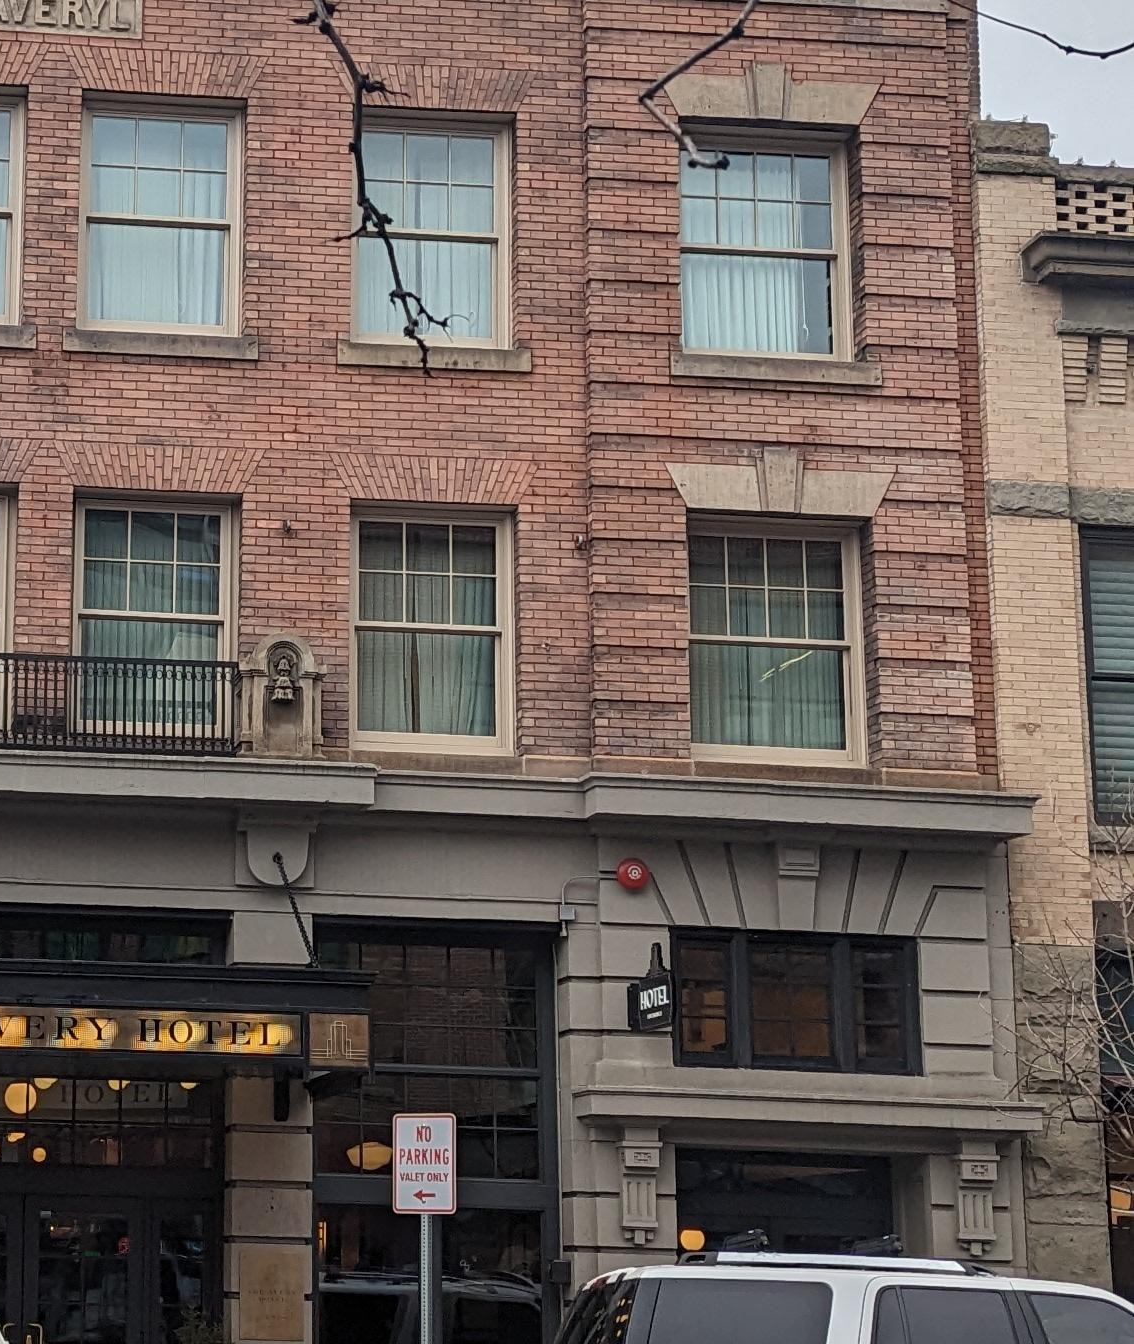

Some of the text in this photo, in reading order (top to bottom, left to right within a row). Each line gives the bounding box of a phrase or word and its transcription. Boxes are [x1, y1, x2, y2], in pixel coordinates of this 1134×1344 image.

[640, 985, 669, 1011] HOTEL
[138, 1018, 282, 1047] HOTEL
[416, 1126, 432, 1142] NO
[399, 1148, 450, 1165] PARKING
[399, 1172, 449, 1182] VALET ONLY
